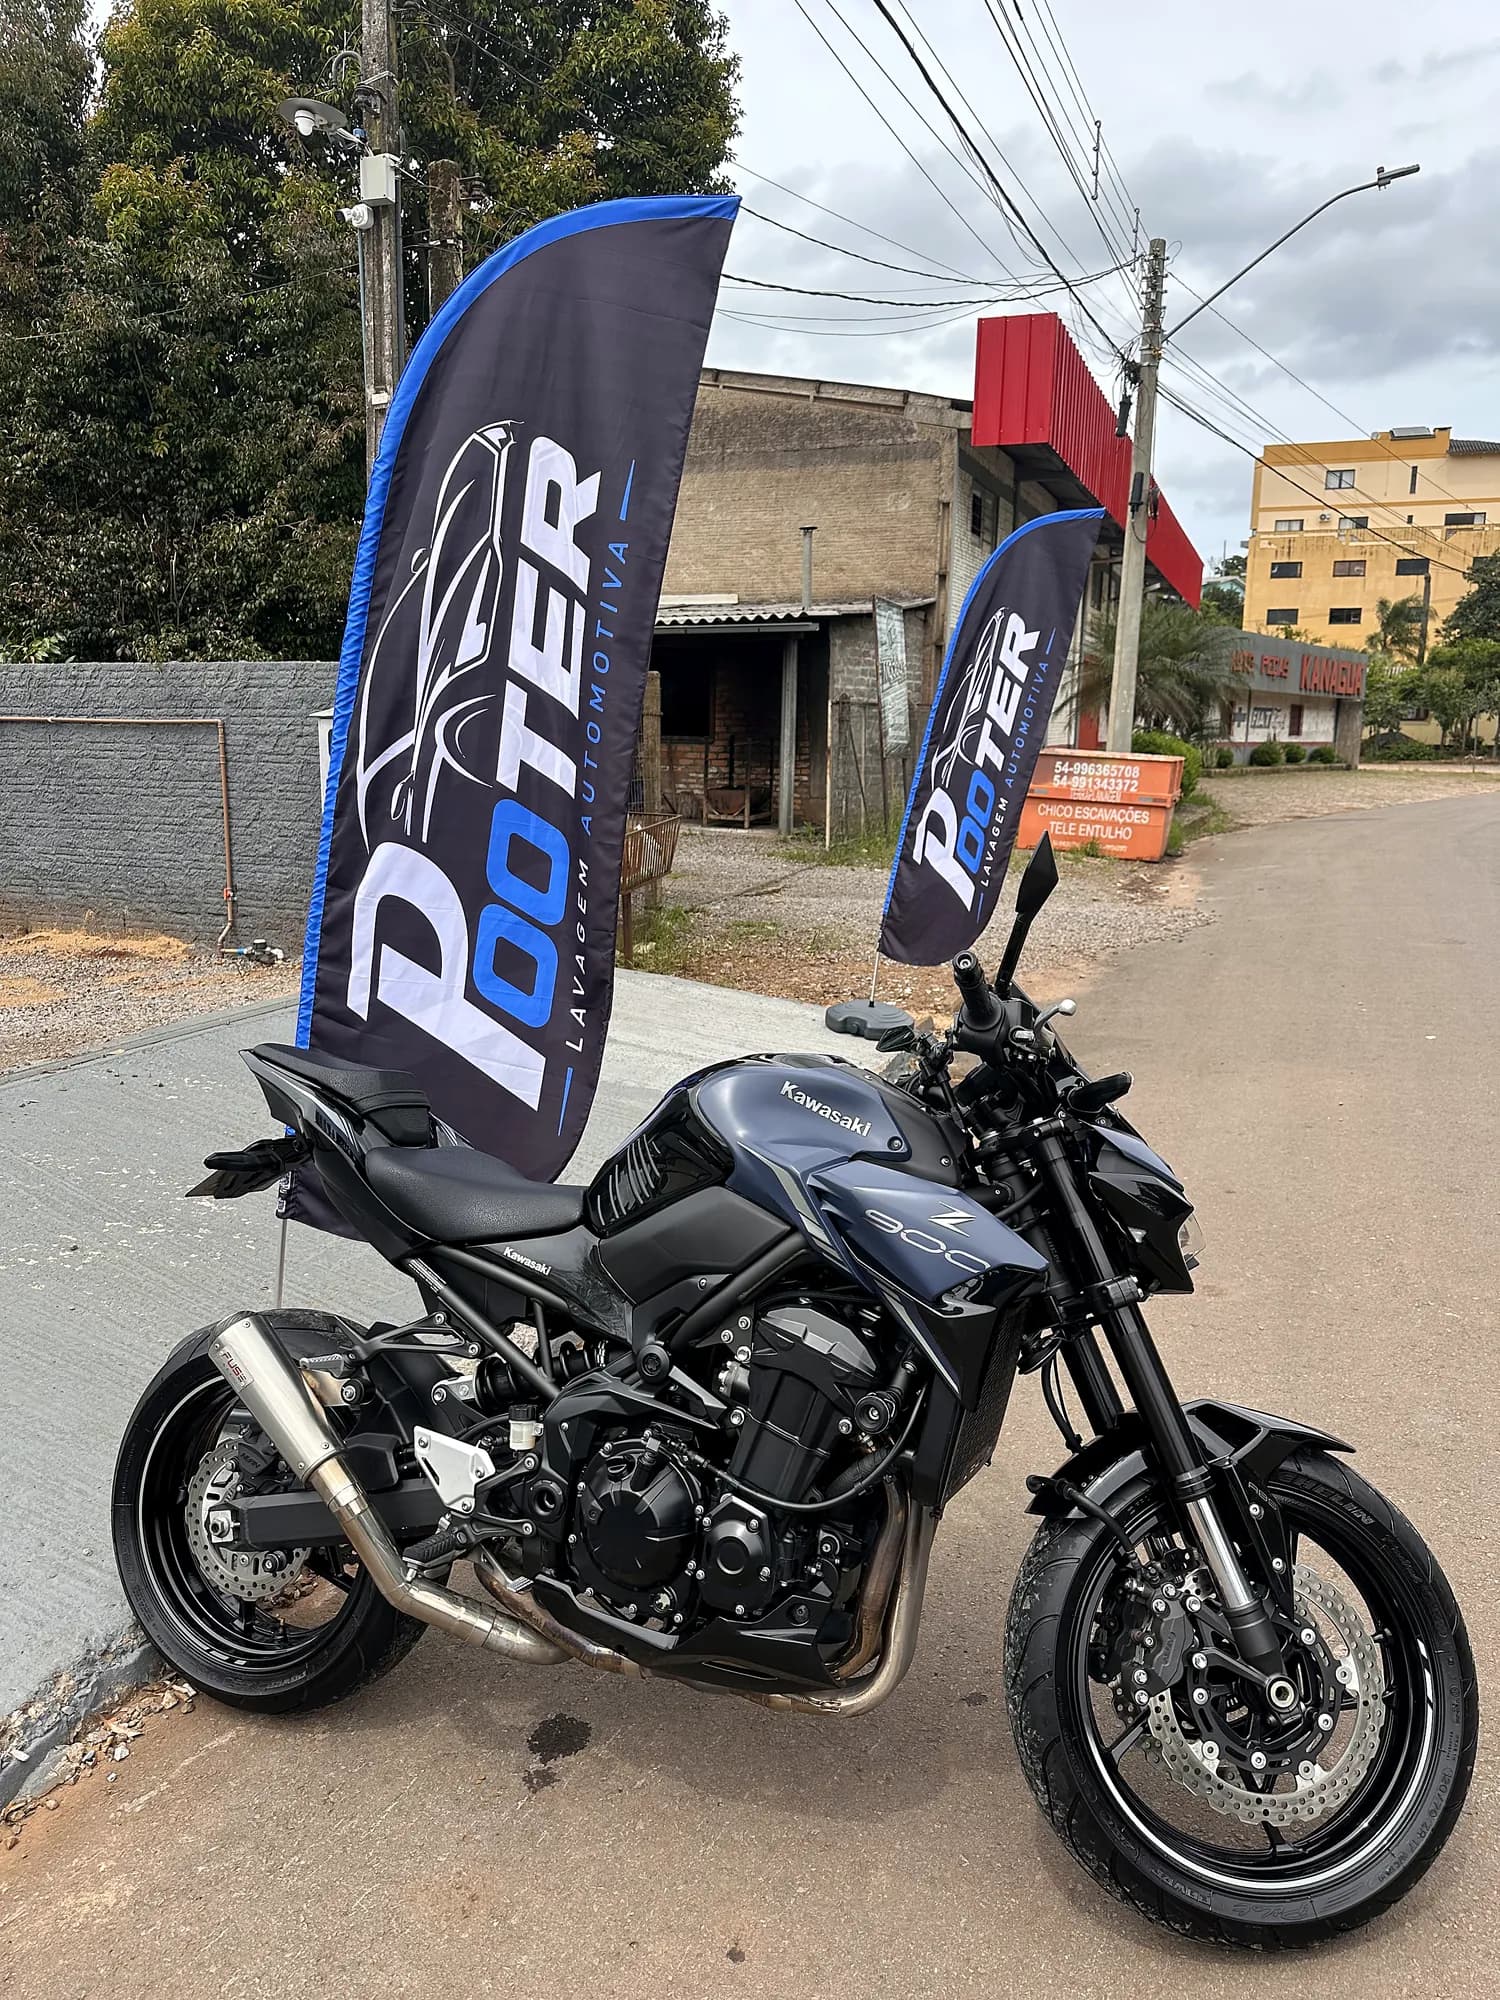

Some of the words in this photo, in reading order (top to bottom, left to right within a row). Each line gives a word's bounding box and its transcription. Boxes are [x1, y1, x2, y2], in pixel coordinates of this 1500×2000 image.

[579, 541, 630, 837] AUTOMOTIVA
[979, 797, 1009, 887] LAVAGEM
[1003, 661, 1049, 789] AUTOMOTIVA
[1052, 774, 1139, 793] 54-991343372
[1054, 761, 1140, 779] 54-996365708
[1037, 803, 1073, 818] CHICO
[1074, 806, 1150, 825] ESCAVAÇÕES
[1049, 821, 1077, 836] TELE
[1078, 824, 1133, 841] ENTULHO
[567, 858, 593, 1052] LAVAGEM
[780, 1080, 872, 1137] Kawasaki
[865, 1209, 991, 1274] 900
[503, 1245, 552, 1276] Kawasaki
[221, 1351, 247, 1383] FUSE
